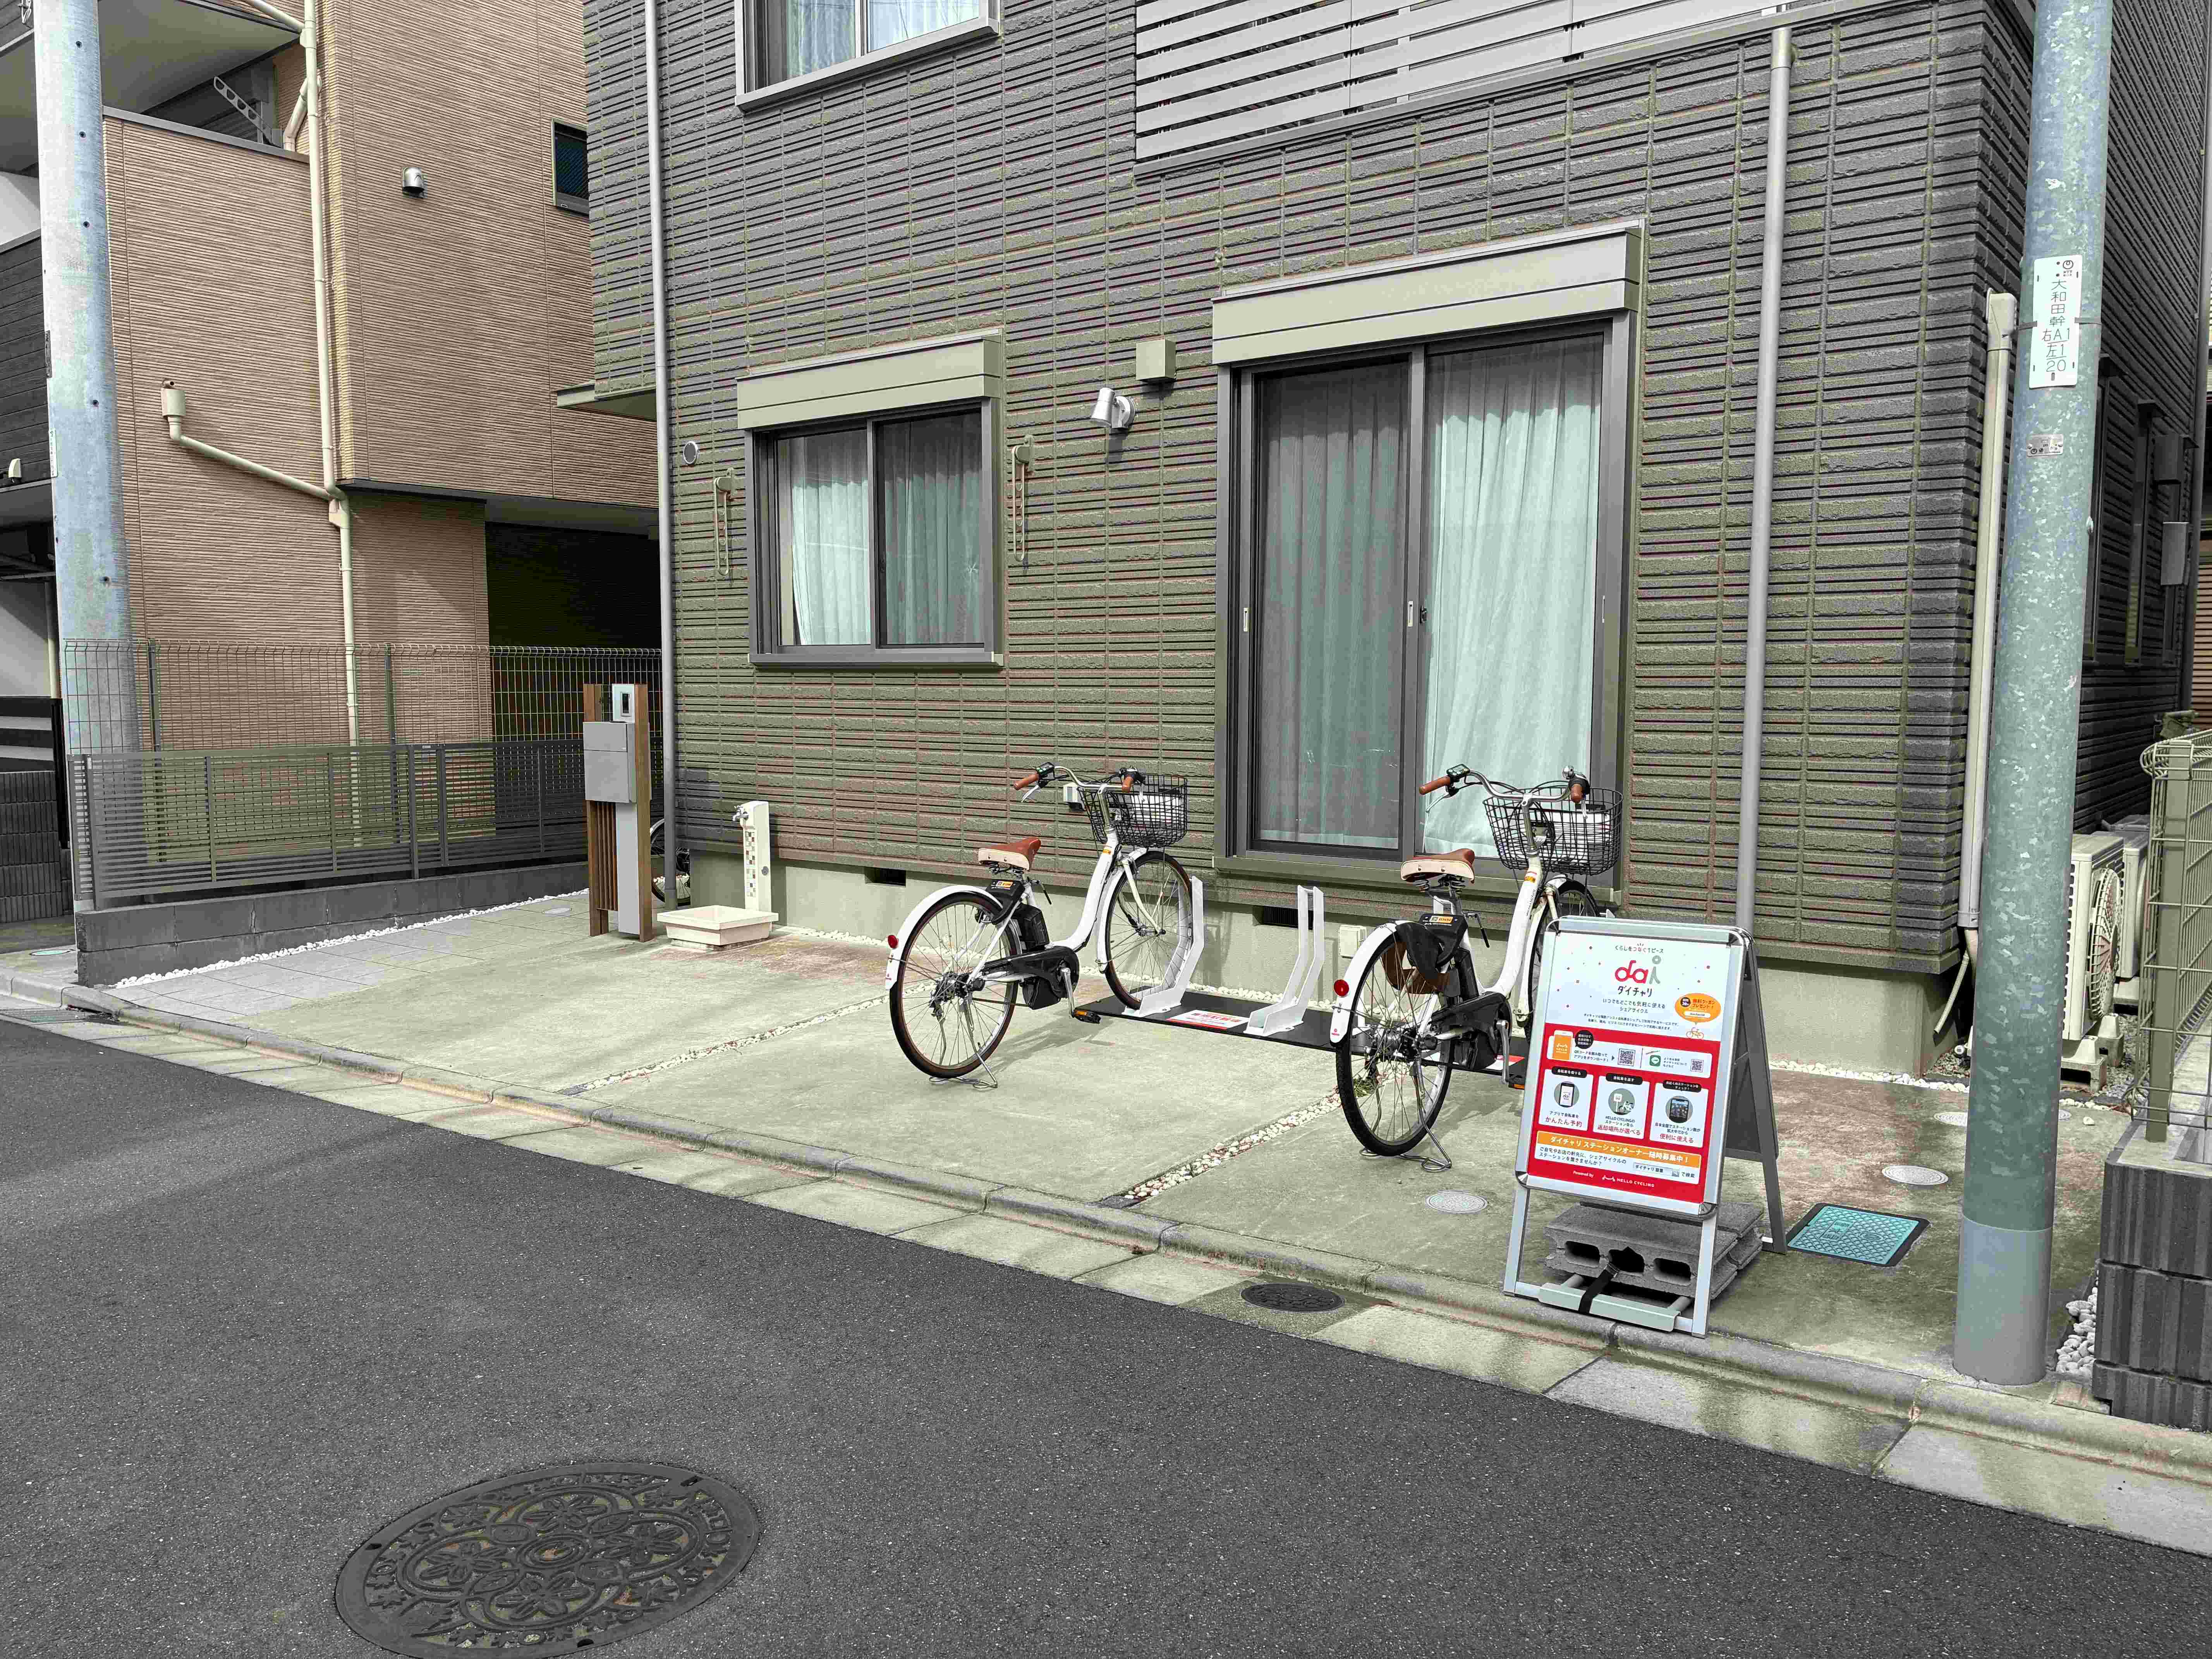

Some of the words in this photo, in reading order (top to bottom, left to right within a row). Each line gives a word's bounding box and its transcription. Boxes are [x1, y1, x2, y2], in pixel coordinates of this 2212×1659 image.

[2046, 359, 2066, 372] 20
[1618, 986, 1652, 997] ダイチャリ
[1602, 998, 1666, 1009] いつでもどこでも気軽に使える
[1546, 1116, 1582, 1127] かんたん予約
[1597, 1125, 1641, 1135] 返却場所が選べる
[1550, 1136, 1582, 1147] ダイチャリ
[1660, 1133, 1694, 1143] 便利に使える
